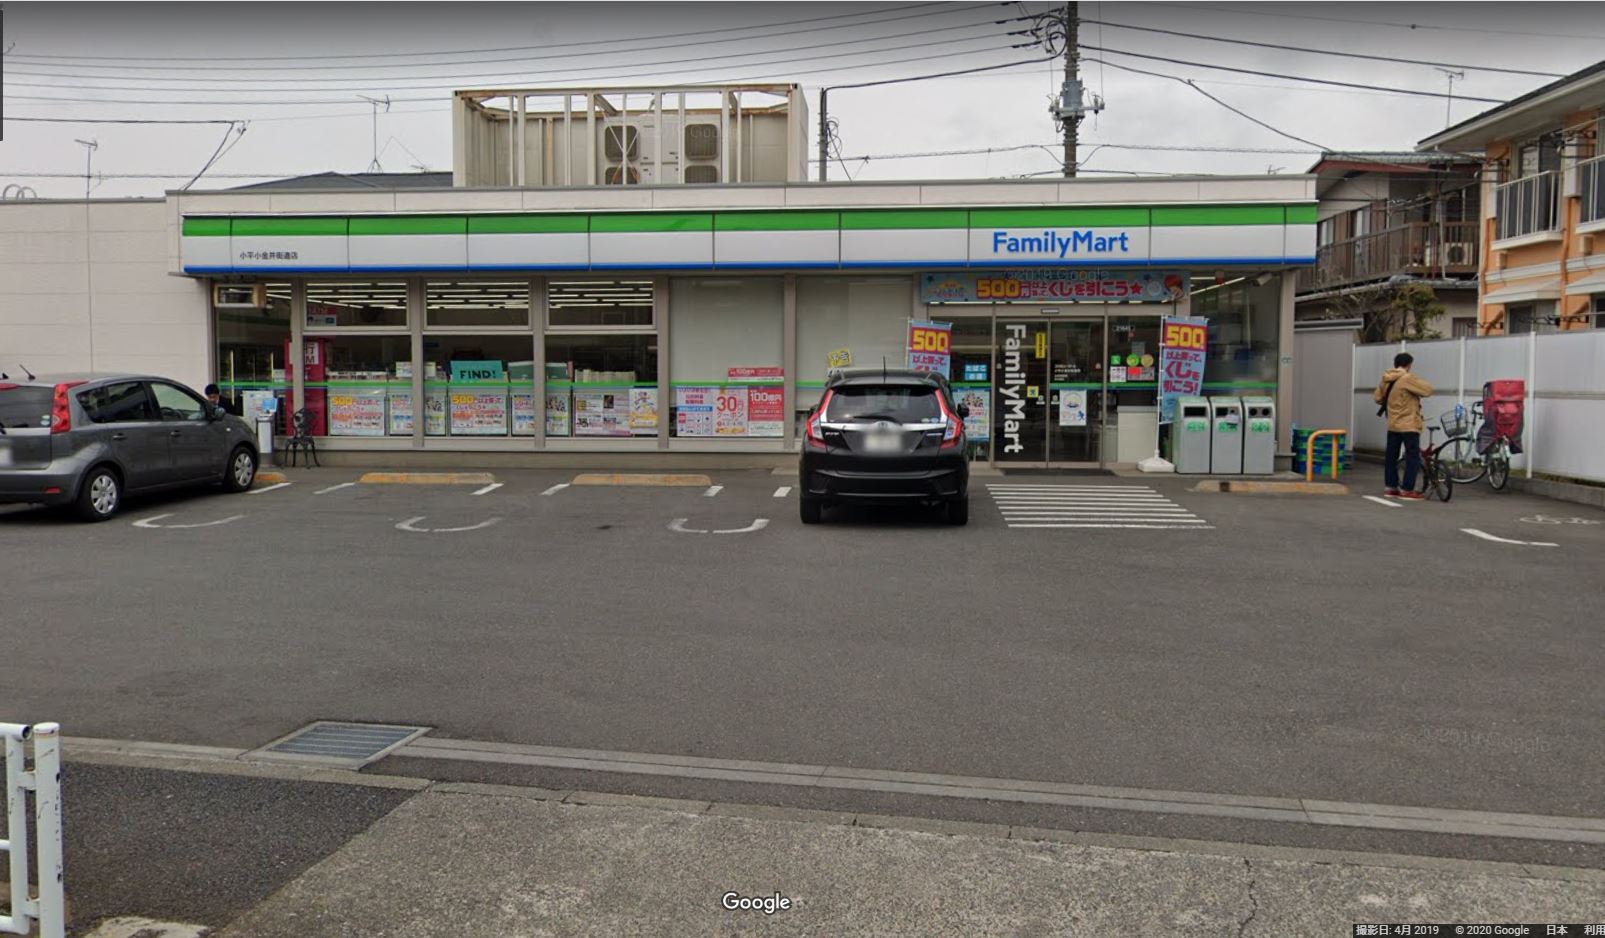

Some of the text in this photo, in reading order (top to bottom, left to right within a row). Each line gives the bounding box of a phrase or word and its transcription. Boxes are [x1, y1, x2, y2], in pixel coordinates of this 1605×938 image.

[993, 231, 1129, 258] FamilyMart
[912, 329, 948, 352] 500
[1166, 325, 1204, 349] 500
[460, 370, 496, 379] FIND!
[999, 324, 1027, 453] FamilyMart
